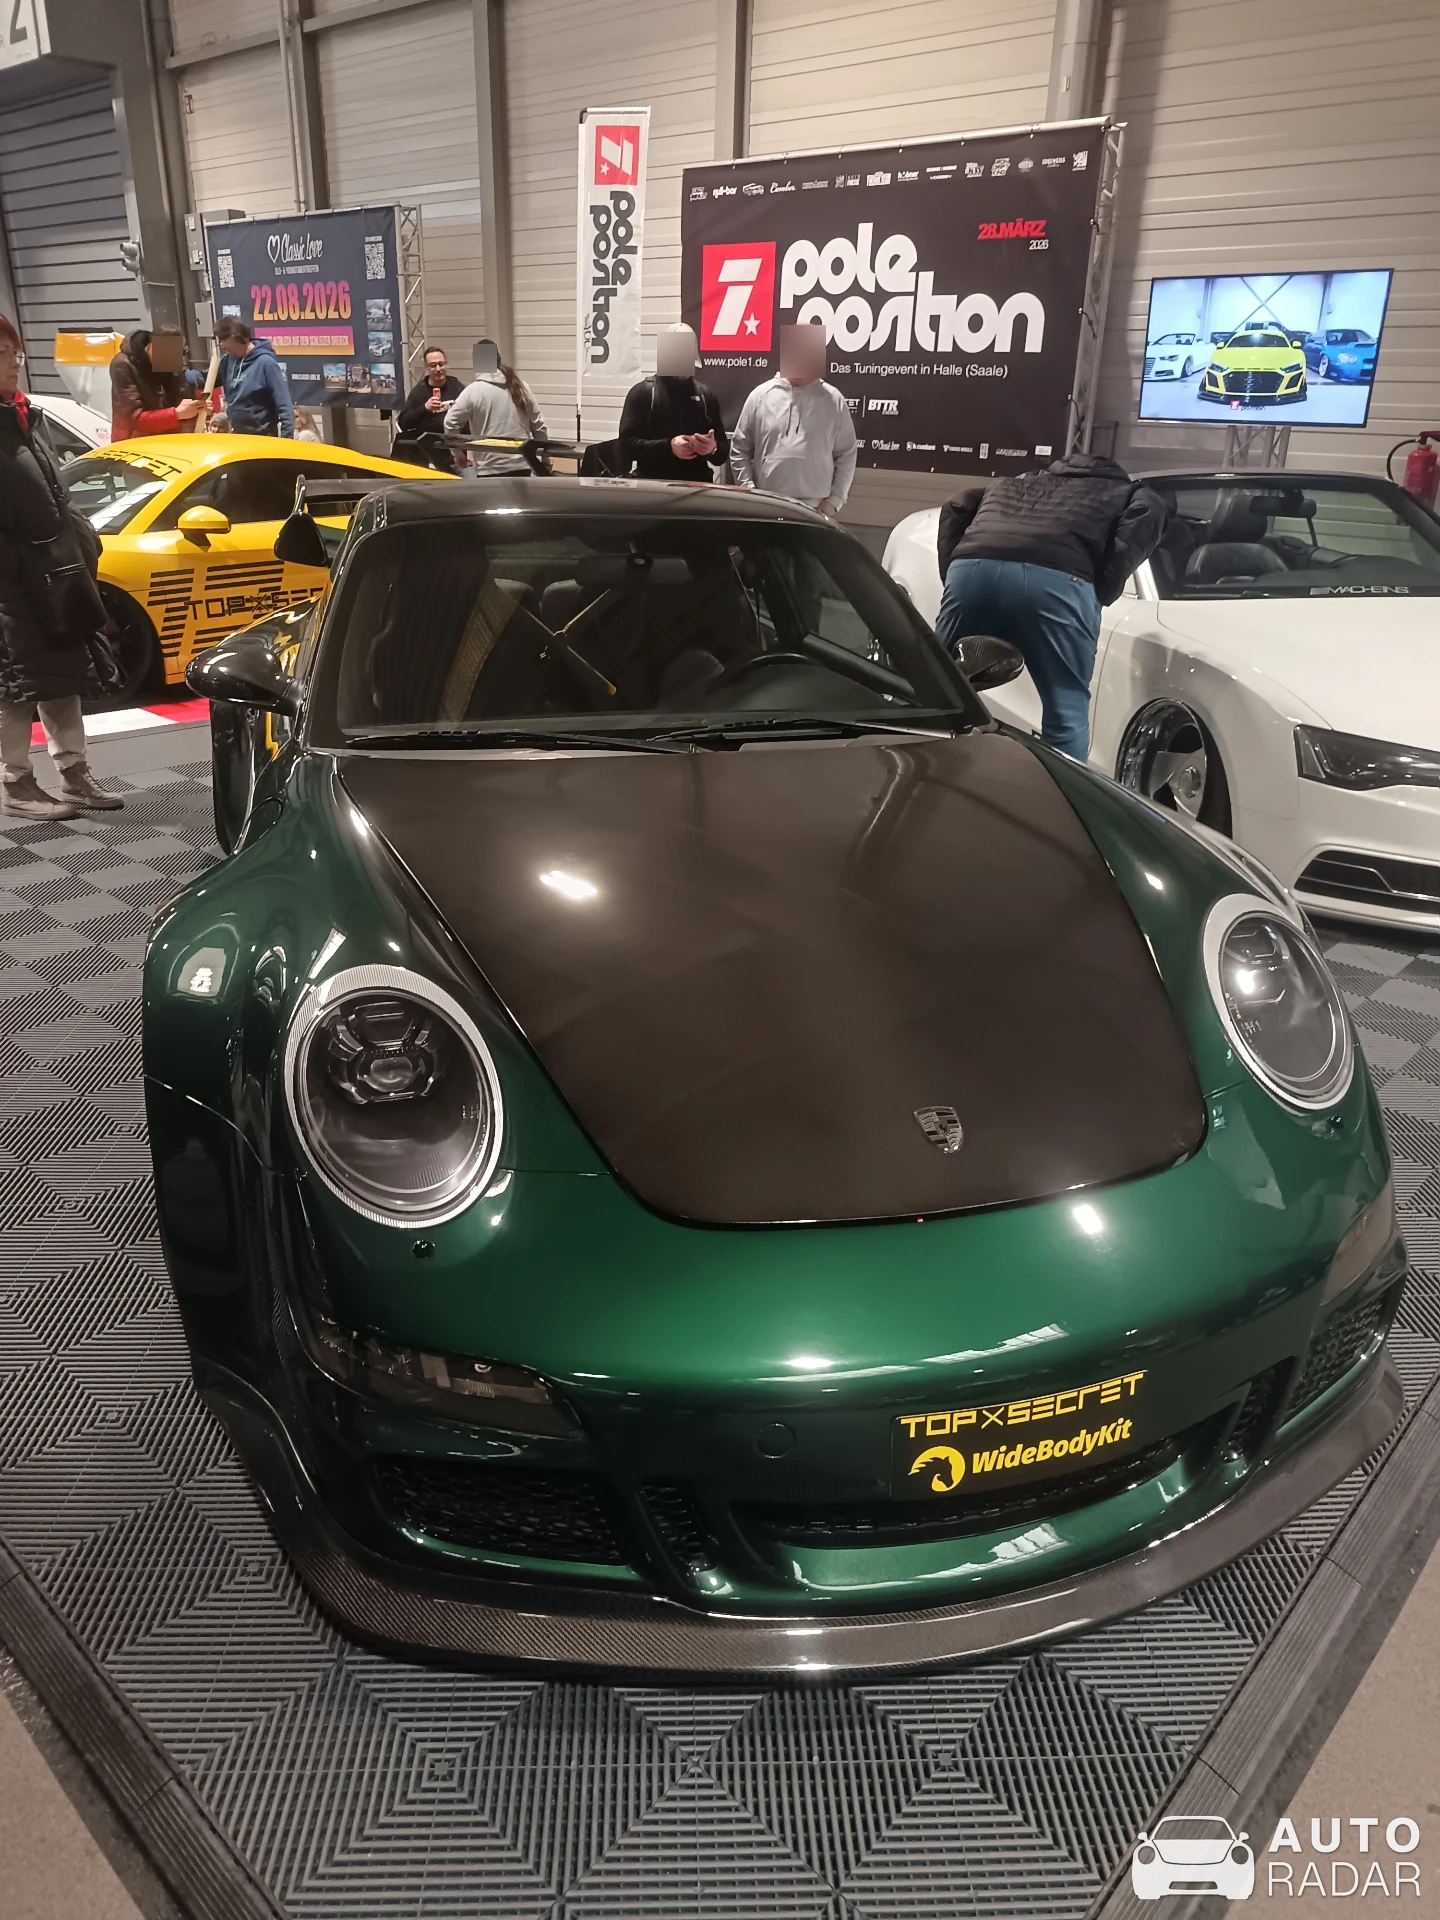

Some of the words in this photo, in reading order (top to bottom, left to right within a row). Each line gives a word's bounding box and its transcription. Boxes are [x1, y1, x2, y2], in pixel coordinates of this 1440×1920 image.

[609, 190, 638, 286] pole
[977, 217, 1047, 240] 28.MÄRZ
[281, 233, 306, 263] Classic
[306, 232, 323, 260] Love
[1029, 239, 1049, 250] 2026
[779, 222, 918, 309] pole
[589, 204, 618, 364] position
[251, 280, 352, 321] 22.08.2026
[703, 356, 768, 369] www.pole1.de
[830, 363, 851, 374] Das
[853, 363, 918, 377] Tuningevent
[920, 364, 931, 375] in
[933, 364, 963, 376] Halle
[965, 364, 1008, 378] (Saale)
[868, 399, 899, 411] BTTR
[972, 1417, 1133, 1474] WideBodyKit
